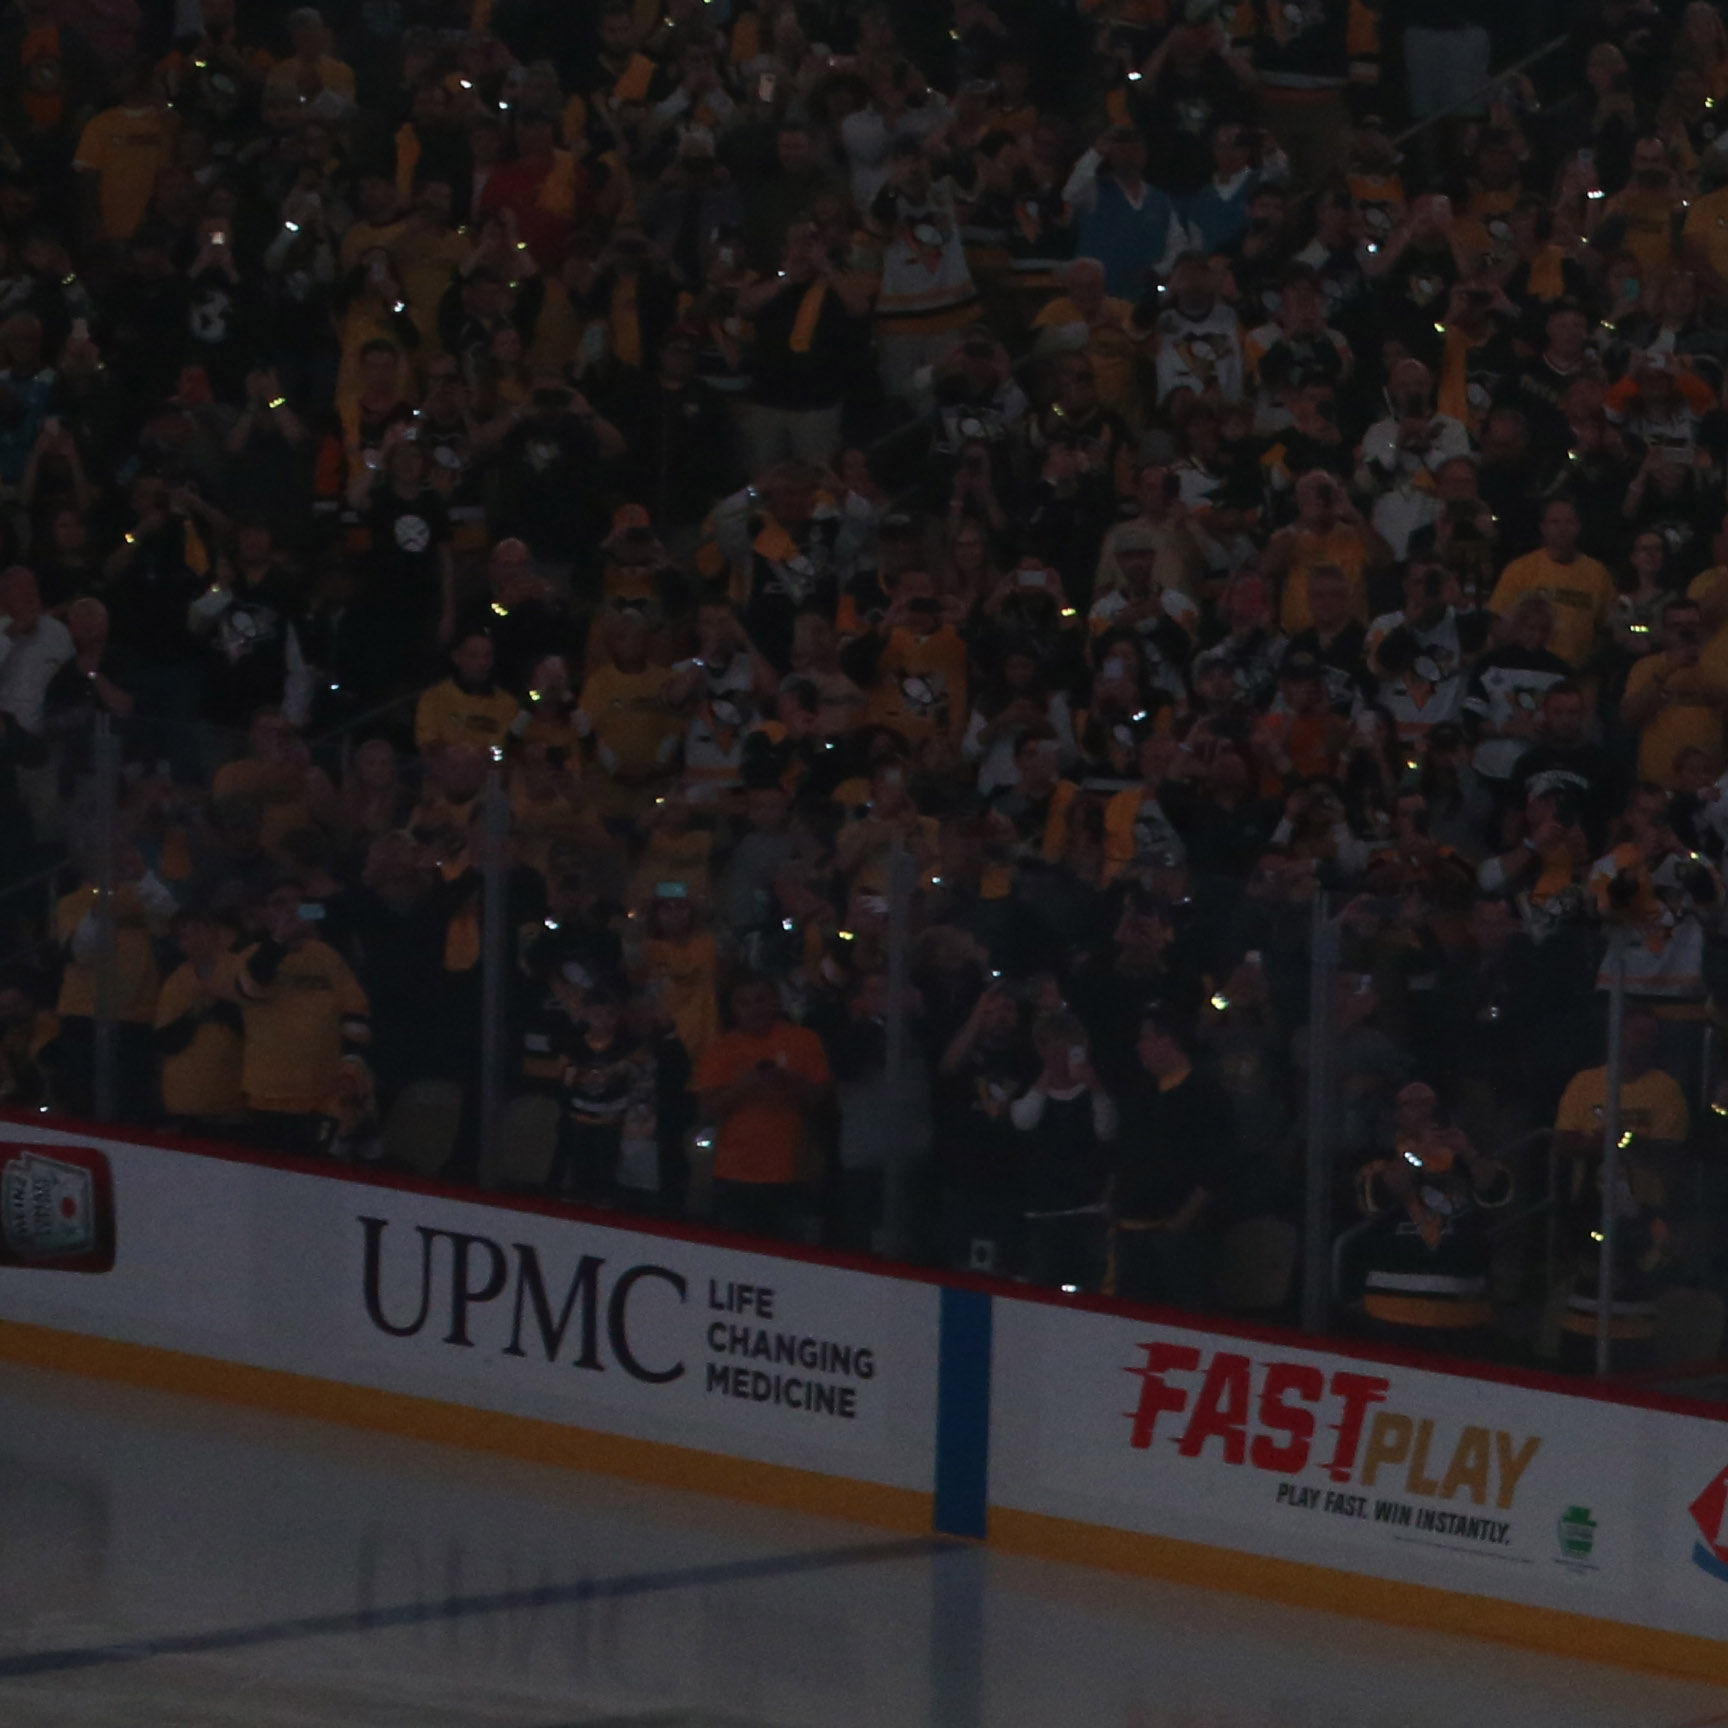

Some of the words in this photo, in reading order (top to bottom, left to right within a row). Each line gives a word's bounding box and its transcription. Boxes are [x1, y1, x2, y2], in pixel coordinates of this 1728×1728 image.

[358, 1216, 687, 1383] UPMC
[709, 1279, 775, 1319] LIFE
[707, 1322, 875, 1380] CHANGING
[705, 1362, 858, 1418] MEDICINE
[1276, 1482, 1322, 1509] PLAY
[1324, 1490, 1368, 1520] FAST.
[1374, 1499, 1411, 1528] WIN
[1416, 1507, 1511, 1546] INSTANTLY.
